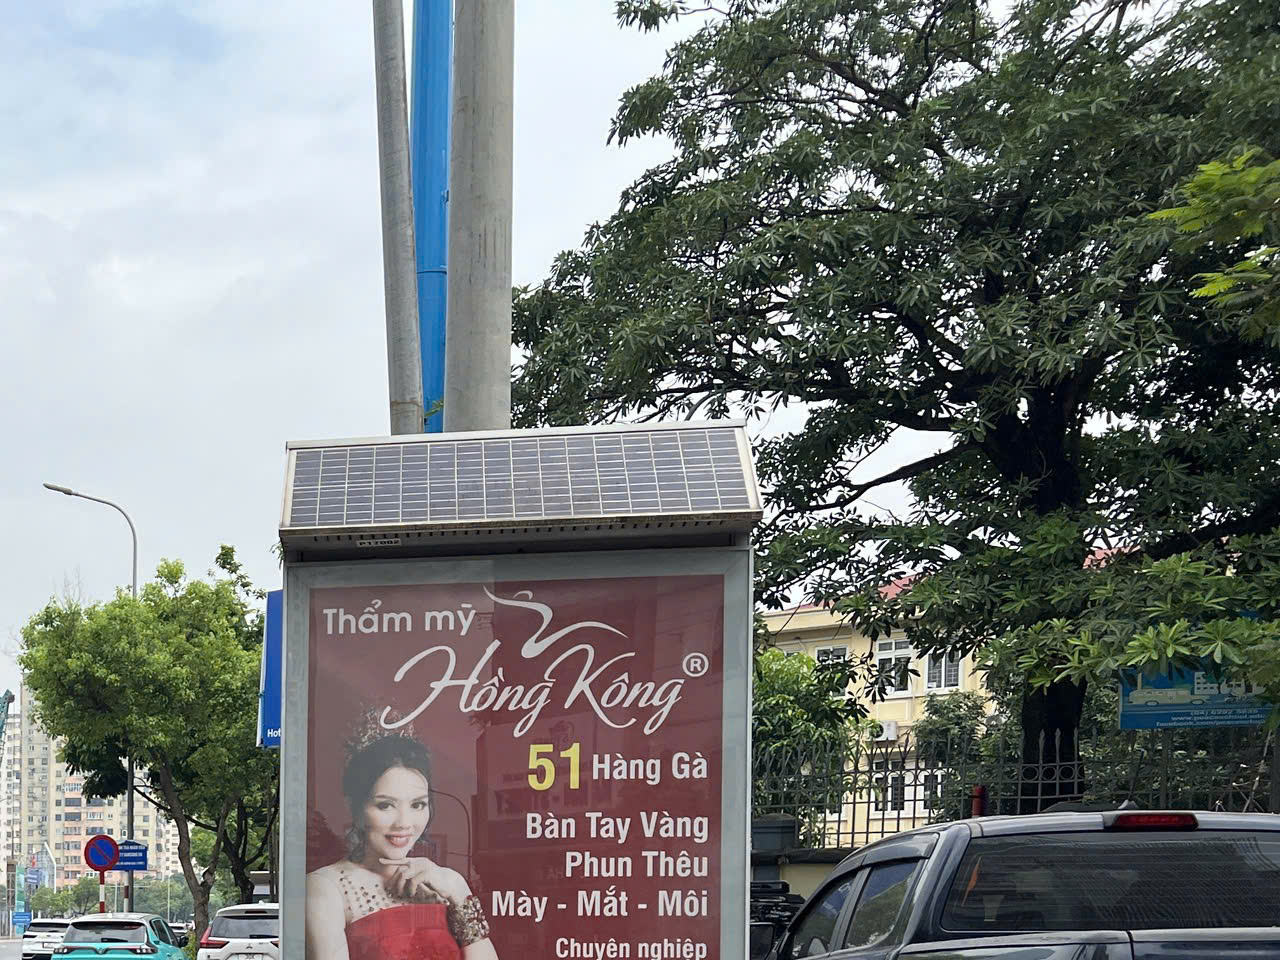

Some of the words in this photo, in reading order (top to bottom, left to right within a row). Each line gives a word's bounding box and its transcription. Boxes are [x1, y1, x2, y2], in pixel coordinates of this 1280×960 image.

[322, 599, 412, 635] Thẩm
[424, 603, 477, 636] mỹ
[380, 638, 552, 738] Hồng
[527, 742, 580, 791] 51
[592, 752, 661, 786] Hàng
[671, 751, 708, 780] Gà
[526, 812, 576, 839] Bàn
[585, 811, 631, 844] Tay
[639, 810, 709, 844] Vàng
[565, 851, 632, 878] Phun
[641, 850, 708, 877] Thêu
[492, 890, 548, 923] Mày
[577, 885, 629, 917] Mắt
[658, 889, 708, 917] Môi
